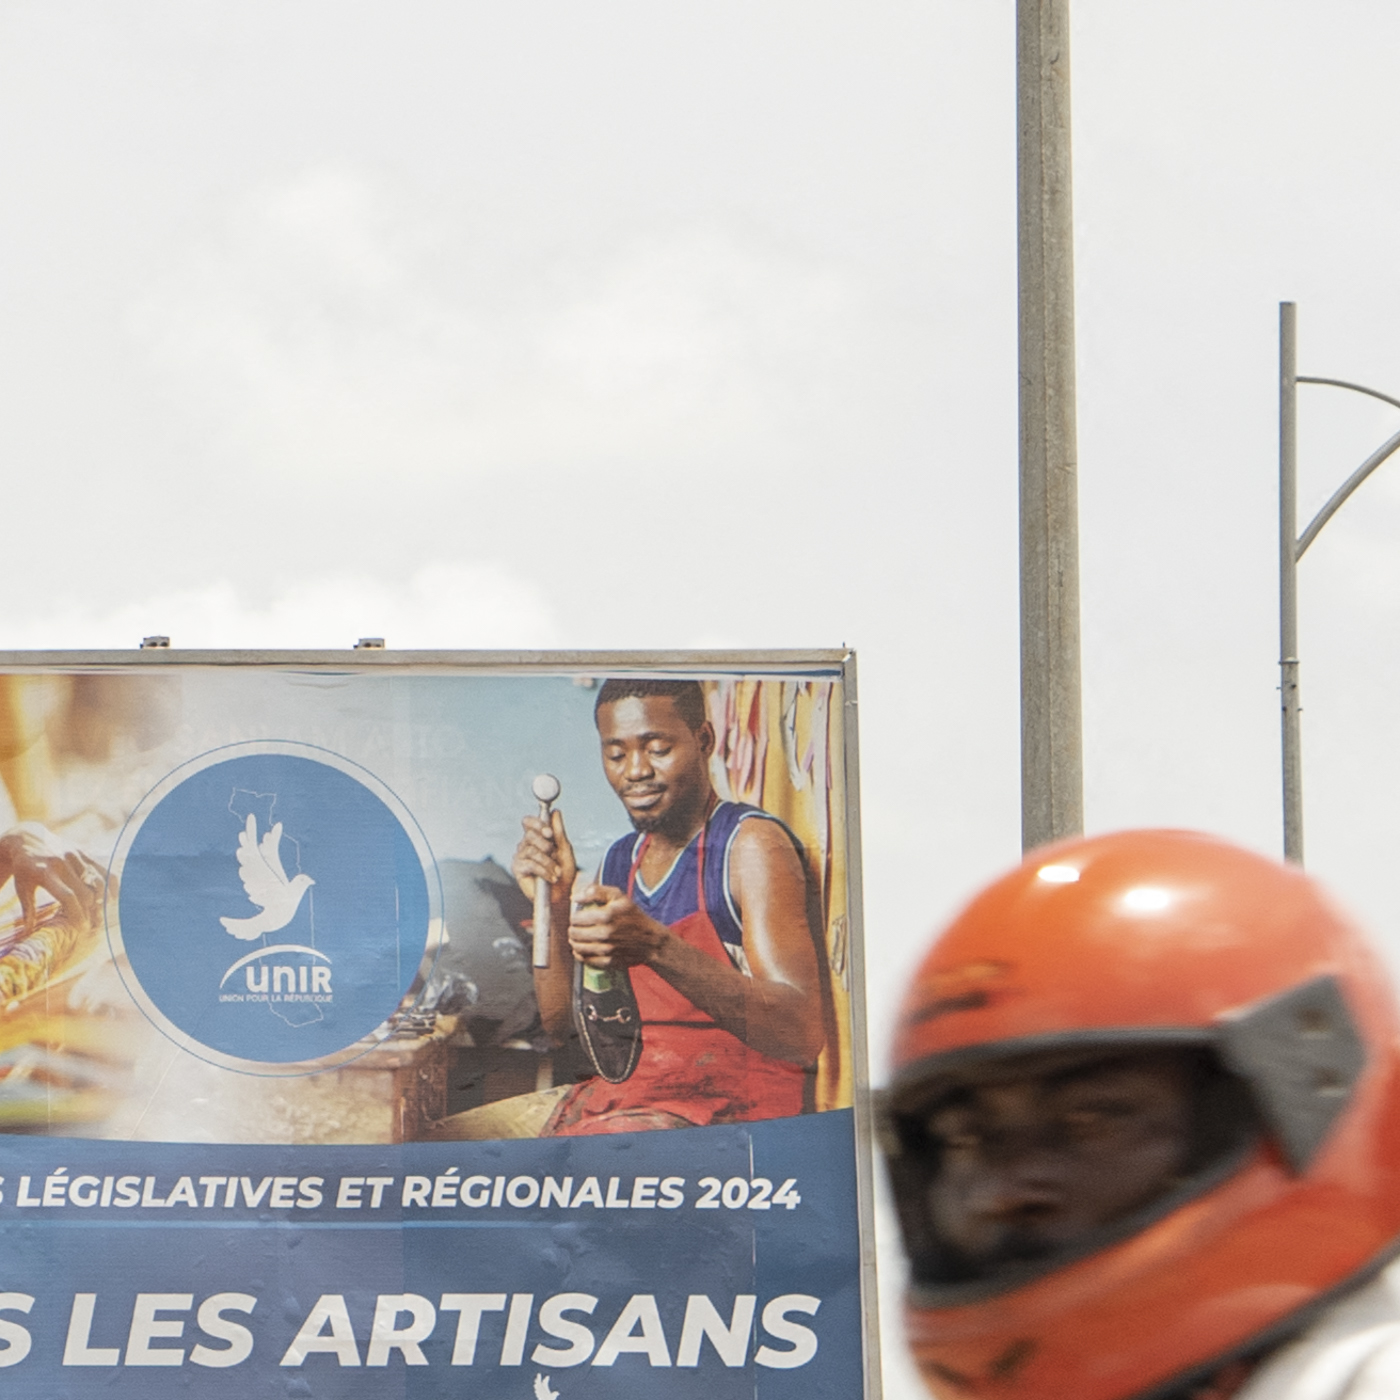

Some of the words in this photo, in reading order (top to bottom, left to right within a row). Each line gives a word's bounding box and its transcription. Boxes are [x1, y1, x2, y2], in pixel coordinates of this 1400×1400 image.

[246, 994, 268, 1002] POUR
[271, 994, 282, 1002] LA
[15, 1166, 323, 1208] LÉGISLATIVES
[334, 1176, 393, 1208] ET
[402, 1167, 683, 1210] RÉGIONALES
[696, 1177, 802, 1210] 2024
[62, 1292, 253, 1369] LES
[280, 1292, 820, 1370] ARTISANS
